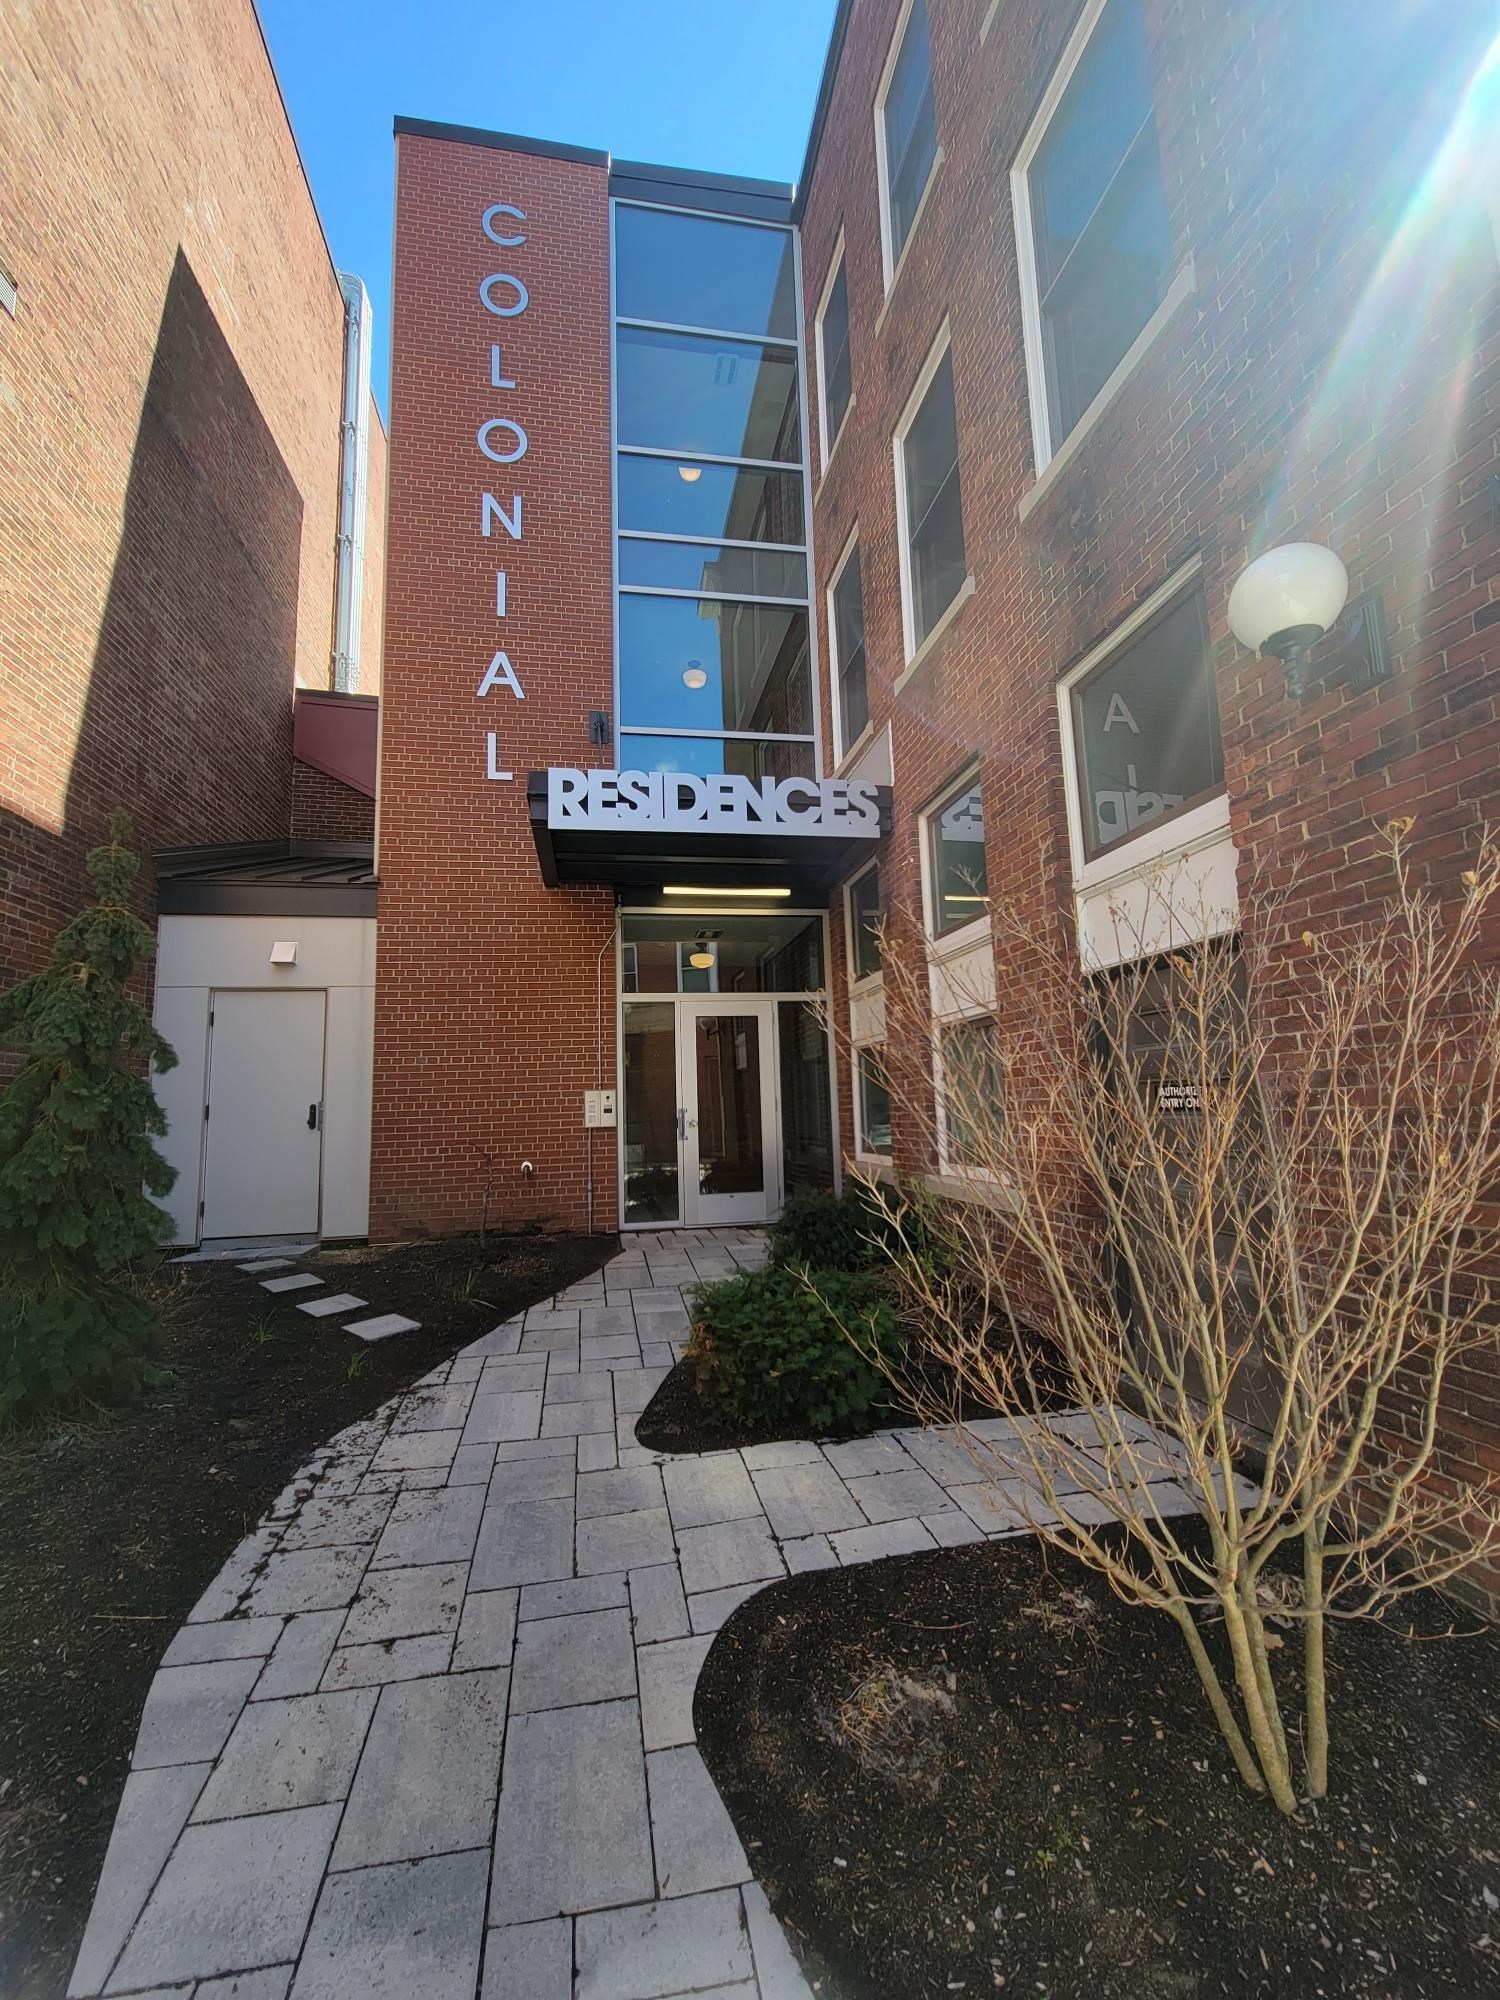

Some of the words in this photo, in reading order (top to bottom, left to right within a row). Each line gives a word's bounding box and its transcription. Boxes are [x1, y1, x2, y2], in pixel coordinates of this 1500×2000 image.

[476, 204, 529, 780] COLONIAL
[548, 767, 881, 838] RESIDENCES
[1160, 1086, 1208, 1097] AUTHORIZ
